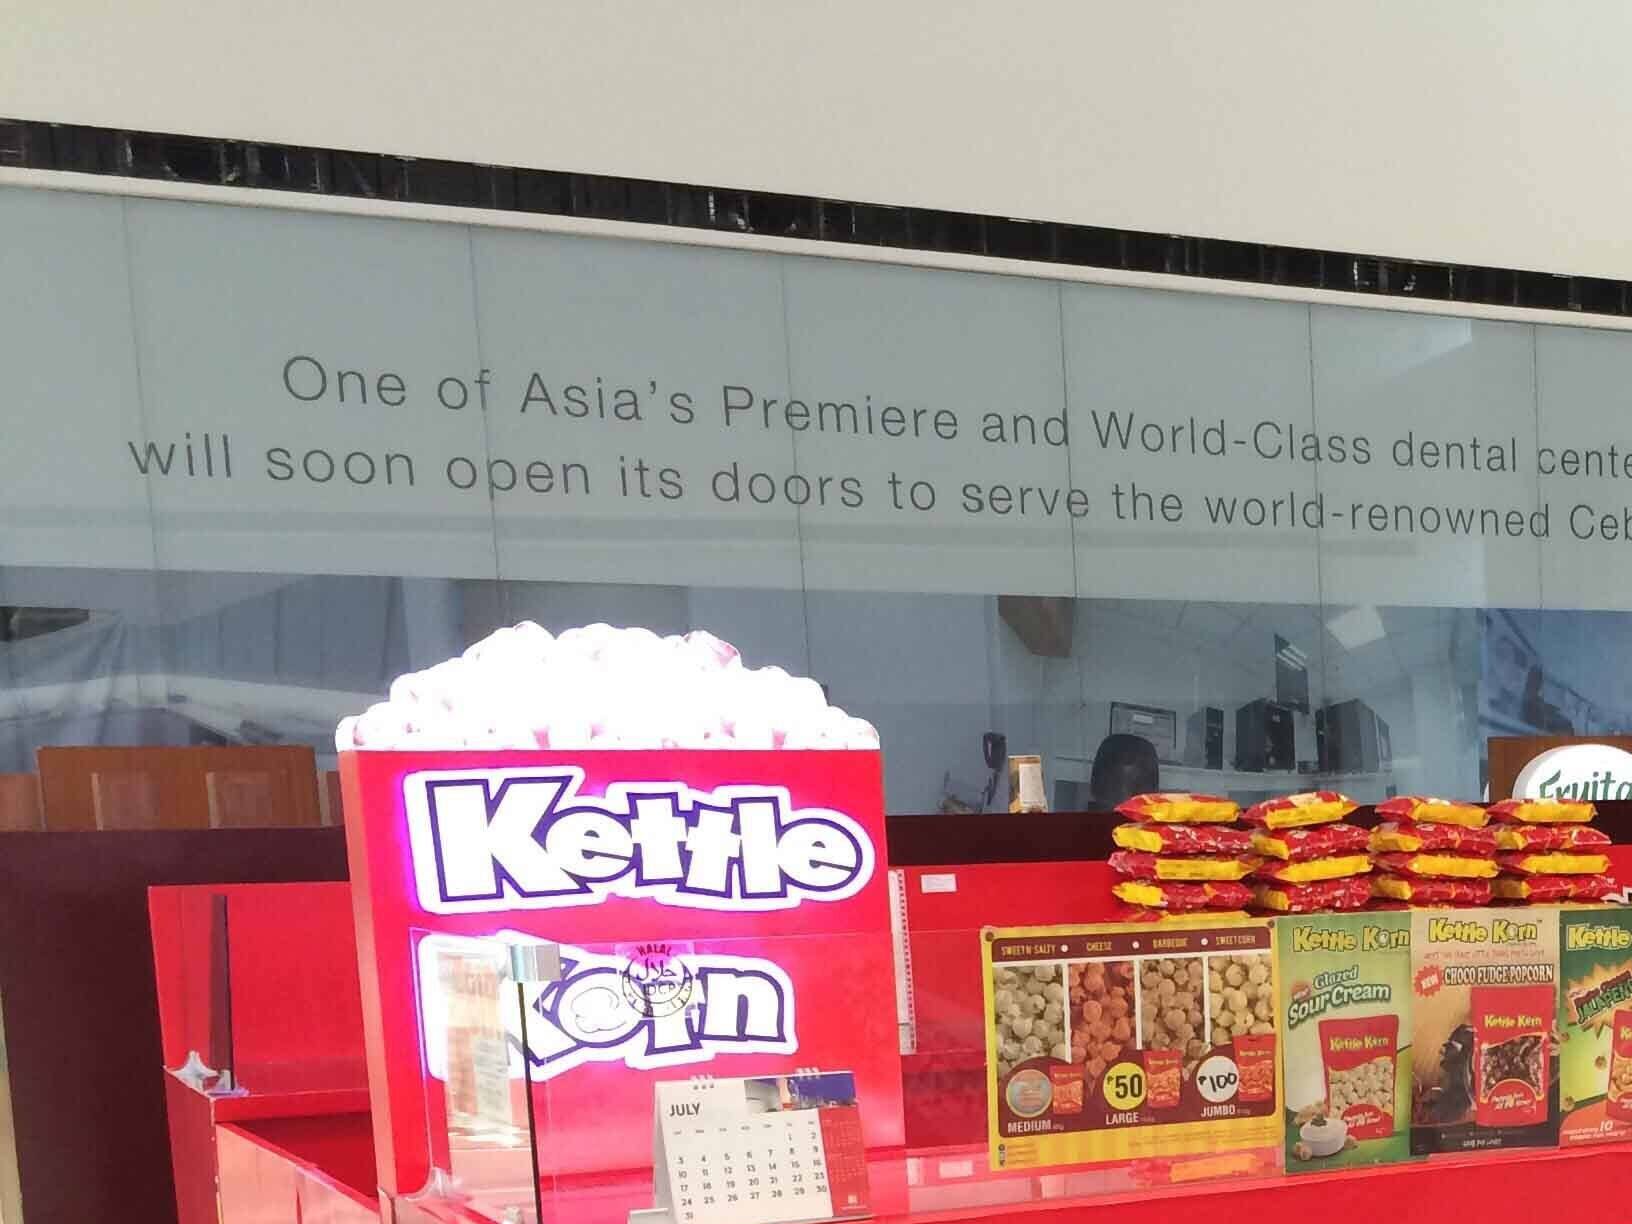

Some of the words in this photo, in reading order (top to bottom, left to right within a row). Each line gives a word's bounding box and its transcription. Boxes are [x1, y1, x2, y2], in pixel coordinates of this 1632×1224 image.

[283, 355, 408, 408] One
[438, 368, 491, 411] of
[520, 371, 695, 426] Asia's
[722, 384, 961, 442] Premiere
[982, 407, 1071, 448] and
[1092, 409, 1372, 466] World-Class
[1392, 431, 1518, 473] dental
[127, 433, 233, 478] will
[266, 445, 415, 487] soon
[446, 452, 590, 502] open
[619, 456, 685, 501] its
[711, 461, 864, 510] doors
[887, 470, 937, 514] to
[961, 480, 1091, 519] serve
[1112, 480, 1184, 523] the
[1205, 490, 1551, 539] world-renowned
[418, 771, 869, 906] Kettle
[1292, 925, 1358, 952] Kettle
[1361, 924, 1411, 952] Korn
[1428, 917, 1489, 943] Kettle
[1491, 918, 1538, 944] Korn
[1566, 922, 1632, 951] Kettle
[1313, 964, 1360, 989] Glazed
[1444, 966, 1476, 985] CHOCO
[1477, 965, 1509, 984] FUDGE
[1509, 963, 1555, 983] POPCORN
[1288, 990, 1332, 1030] Sour
[1330, 983, 1392, 1008] Cream
[668, 1102, 701, 1117] JULY
[1105, 1111, 1139, 1125] LARGE
[1200, 1105, 1236, 1117] JUMBO
[1007, 1119, 1052, 1133] MEDIUM
[678, 1171, 688, 1179] 10
[724, 1166, 733, 1175] 12
[768, 1163, 777, 1171] 14
[680, 1184, 688, 1193] 17
[748, 1178, 760, 1187] 20
[791, 1174, 802, 1182] 22
[681, 1198, 692, 1206] 24
[727, 1194, 738, 1202] 26
[749, 1192, 760, 1200] 27
